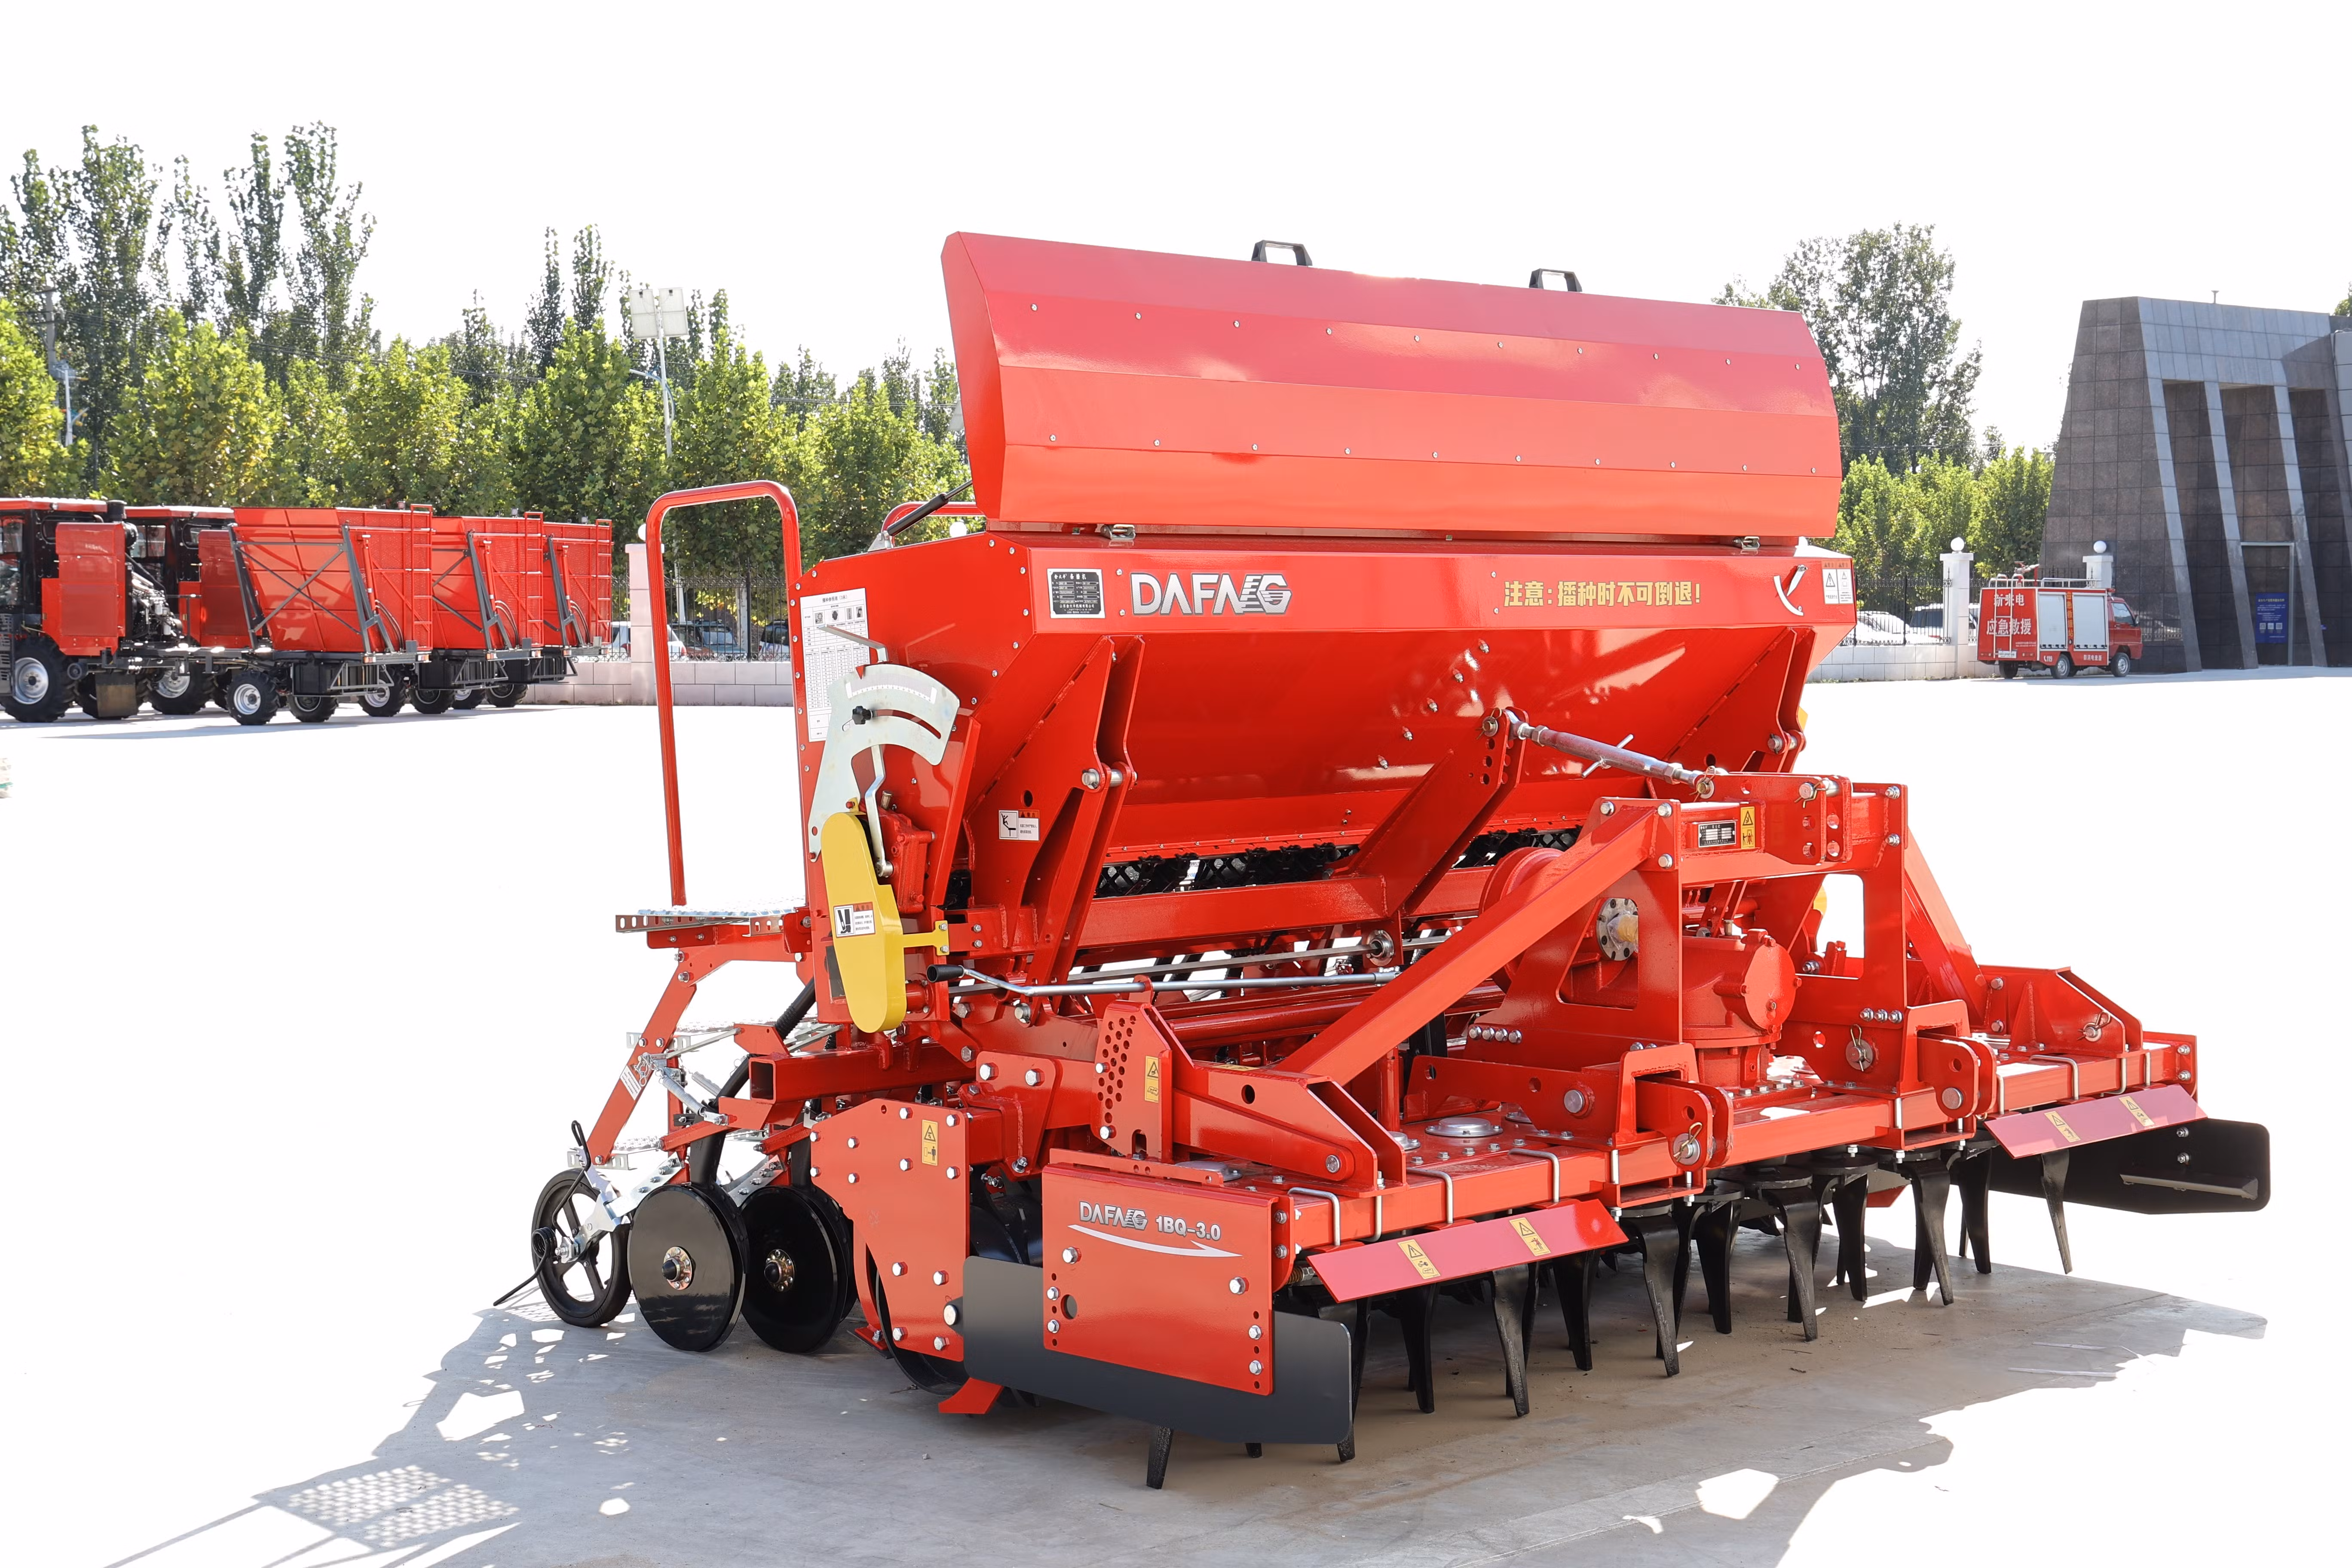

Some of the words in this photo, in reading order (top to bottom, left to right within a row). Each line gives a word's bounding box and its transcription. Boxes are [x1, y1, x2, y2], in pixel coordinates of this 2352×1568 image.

[1994, 593, 2024, 606] 新来电
[1986, 618, 2031, 635] 应急救援
[1155, 1215, 1222, 1241] 1BQ-3.0
